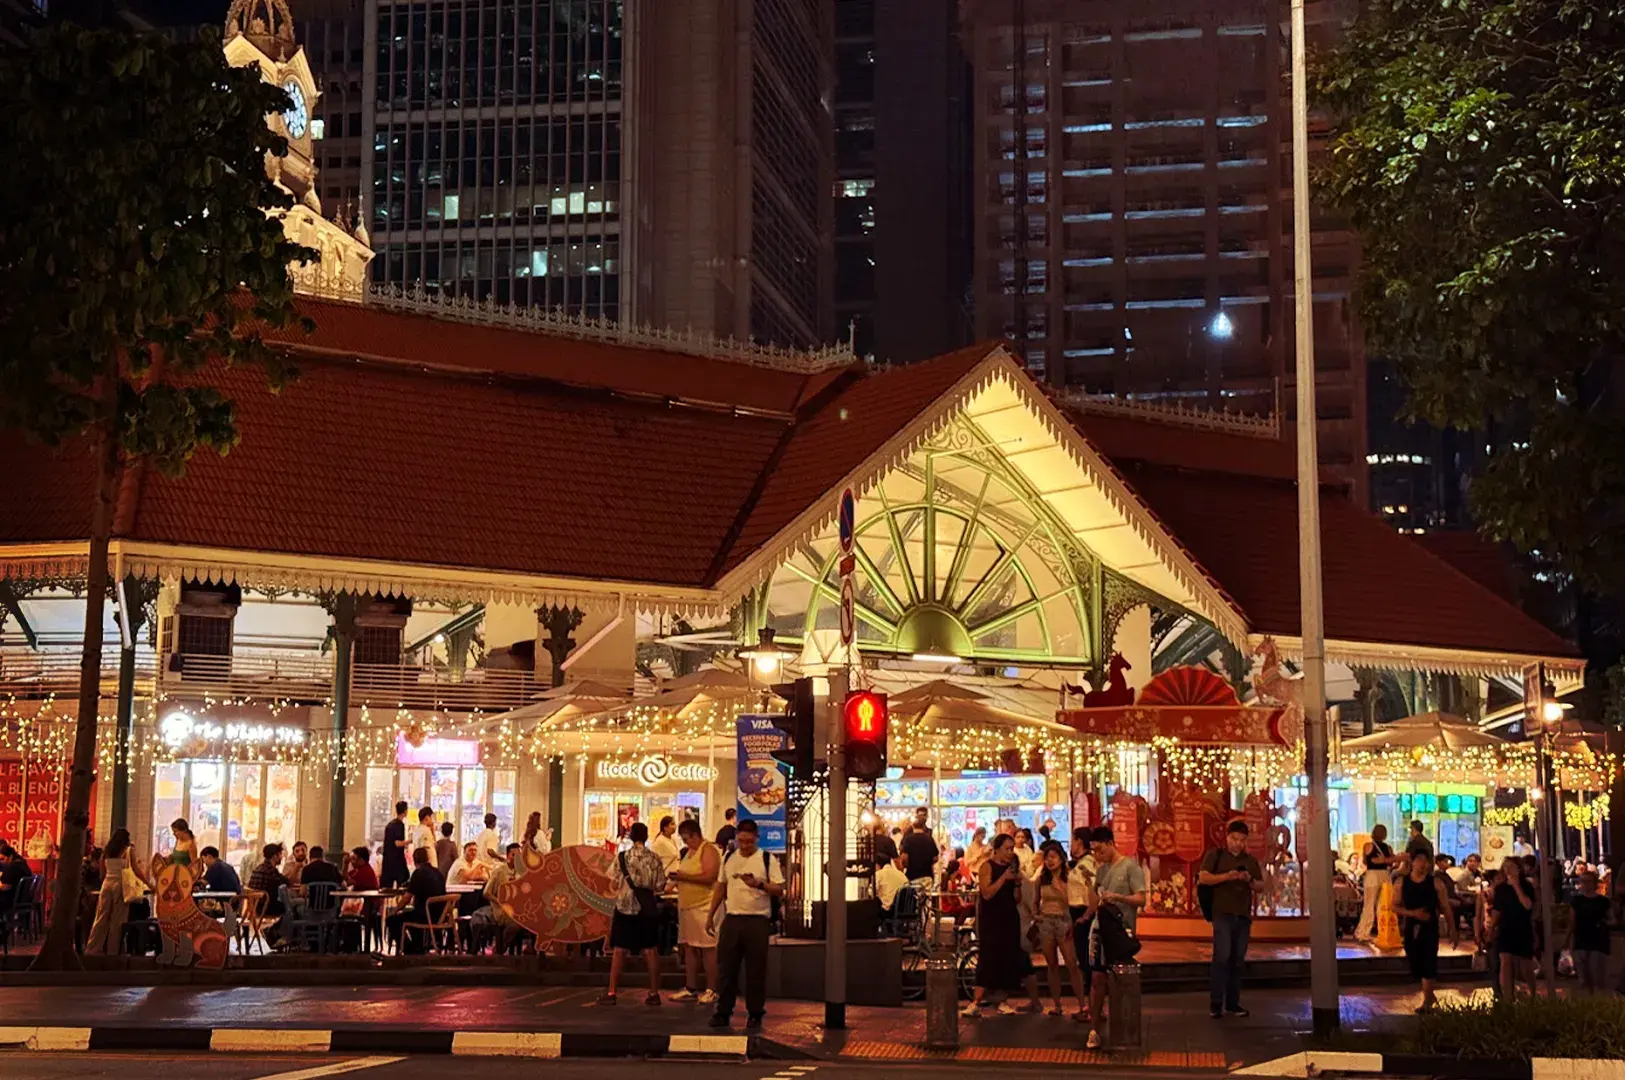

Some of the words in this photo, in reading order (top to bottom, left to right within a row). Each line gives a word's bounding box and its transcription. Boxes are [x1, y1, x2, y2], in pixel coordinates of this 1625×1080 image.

[751, 720, 774, 729] VISA
[598, 760, 638, 777] Hook
[6, 819, 52, 833] GIFTS
